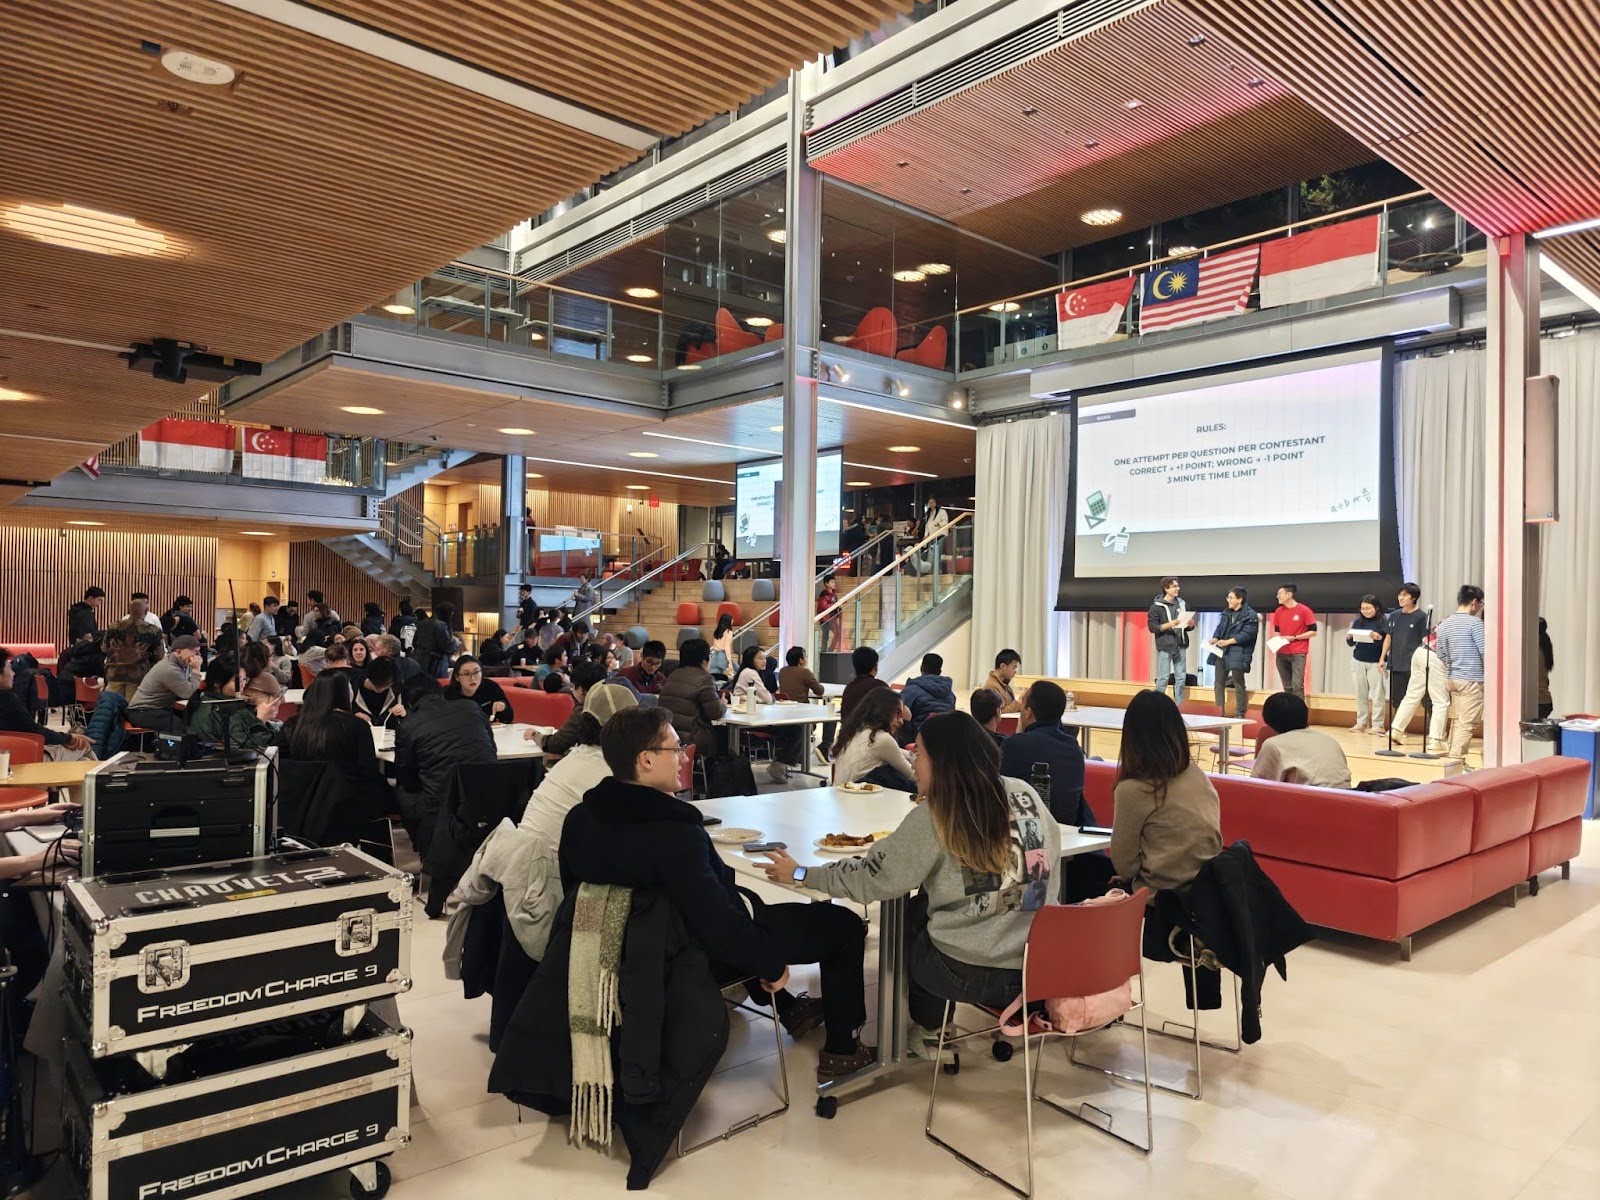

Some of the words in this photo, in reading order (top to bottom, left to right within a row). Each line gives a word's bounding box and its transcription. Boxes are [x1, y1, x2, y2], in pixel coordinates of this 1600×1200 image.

[1196, 423, 1226, 433] RULES:
[1114, 458, 1131, 466] ONE
[1133, 453, 1170, 464] ATTEMPT
[1172, 451, 1188, 460] PER
[1190, 446, 1235, 458] QUESTION
[1238, 444, 1257, 452] PER
[1259, 435, 1326, 450] CONTESTANT
[1129, 465, 1167, 476] CORRECT
[1185, 460, 1214, 470] POINT;
[1216, 456, 1253, 467] WRONG
[1273, 451, 1304, 462] POINT
[1167, 476, 1172, 484] 3
[1173, 473, 1206, 483] MINUTE
[1208, 471, 1230, 480] TIME
[1232, 468, 1257, 478] LIMIT
[135, 872, 294, 904] CHAUVET
[365, 964, 378, 977] 9
[366, 1123, 379, 1137] 9
